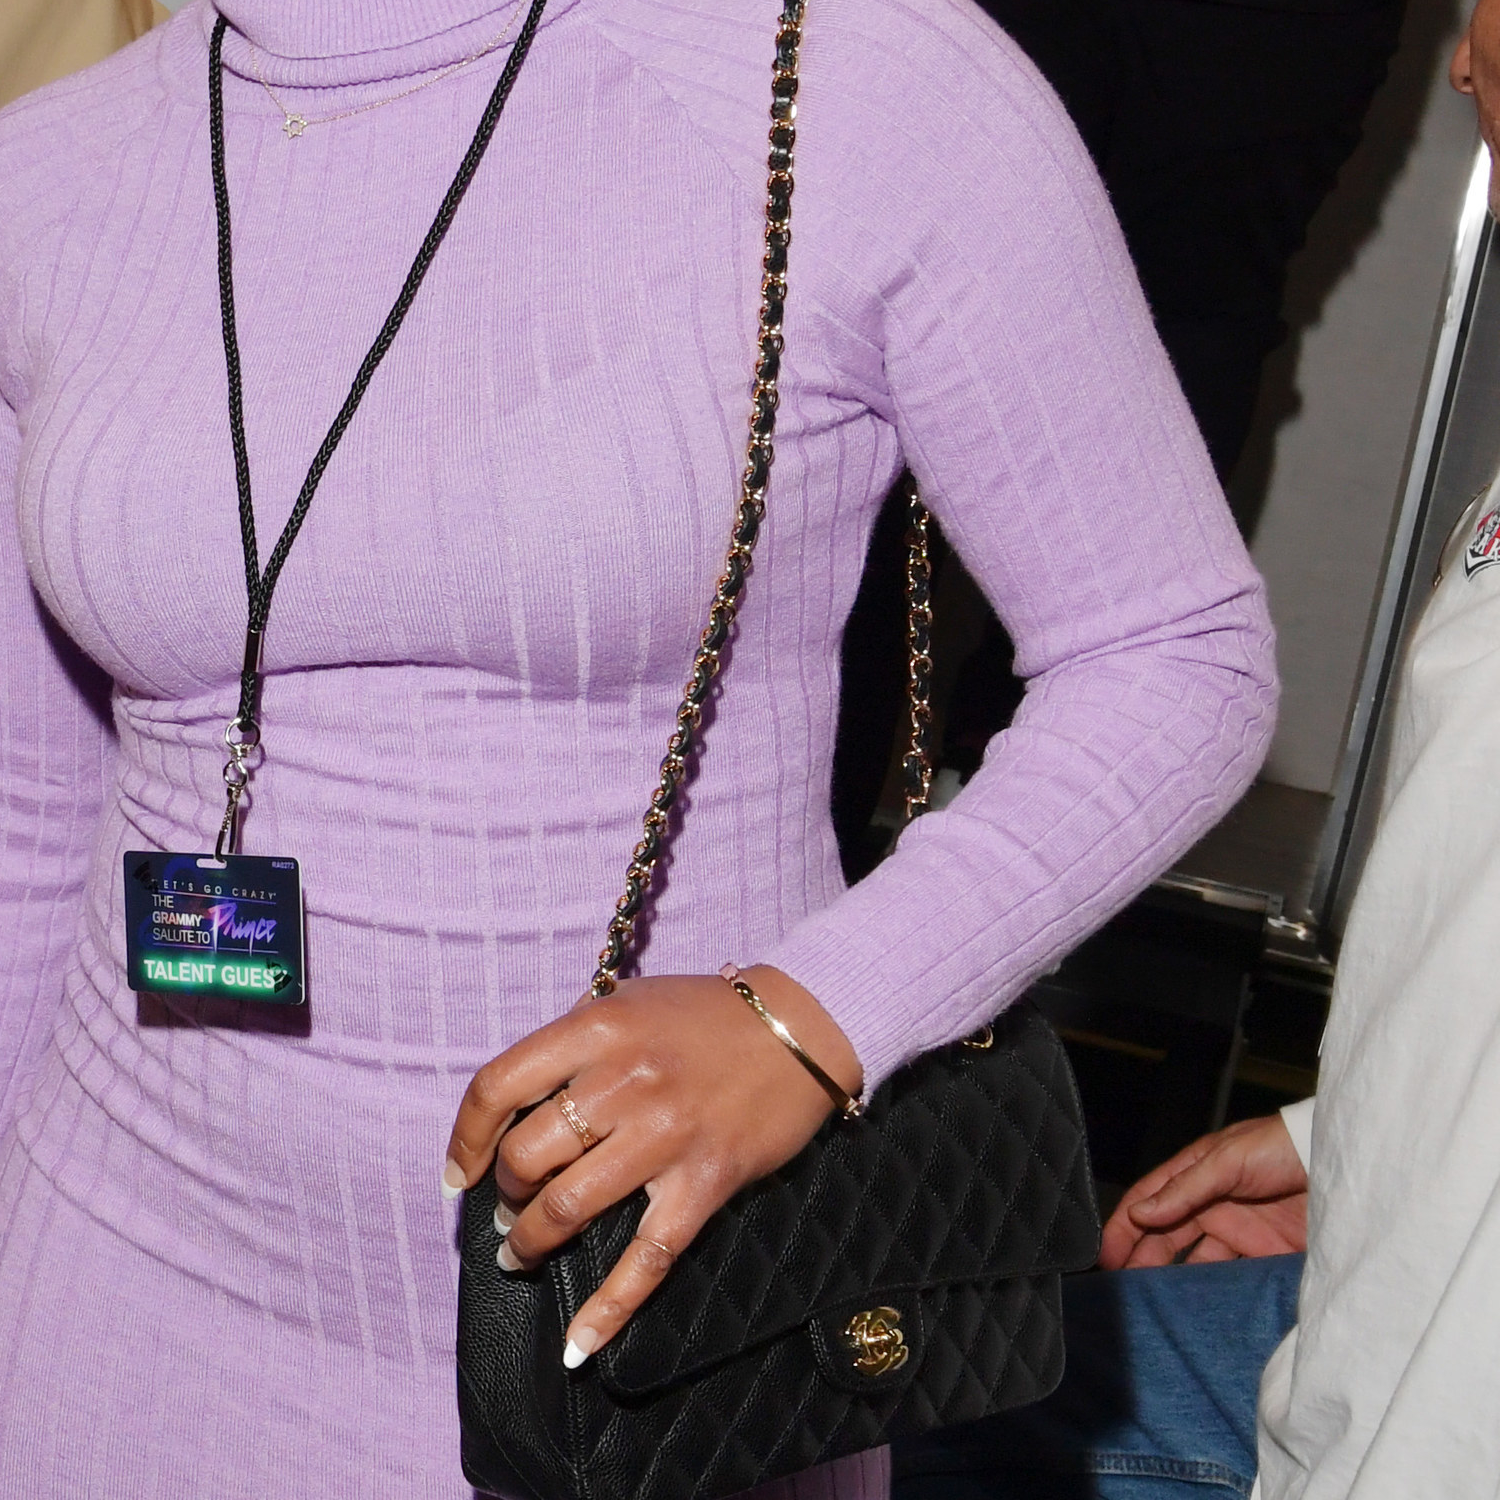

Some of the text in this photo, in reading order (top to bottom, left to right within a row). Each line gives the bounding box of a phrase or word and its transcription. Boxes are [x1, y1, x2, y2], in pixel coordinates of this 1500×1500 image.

[203, 884, 223, 896] GO
[151, 893, 175, 909] THE
[152, 911, 203, 927] GRAMMY
[152, 927, 211, 945] SALUTE TO
[207, 902, 277, 957] Prince
[143, 959, 217, 984] TALENT
